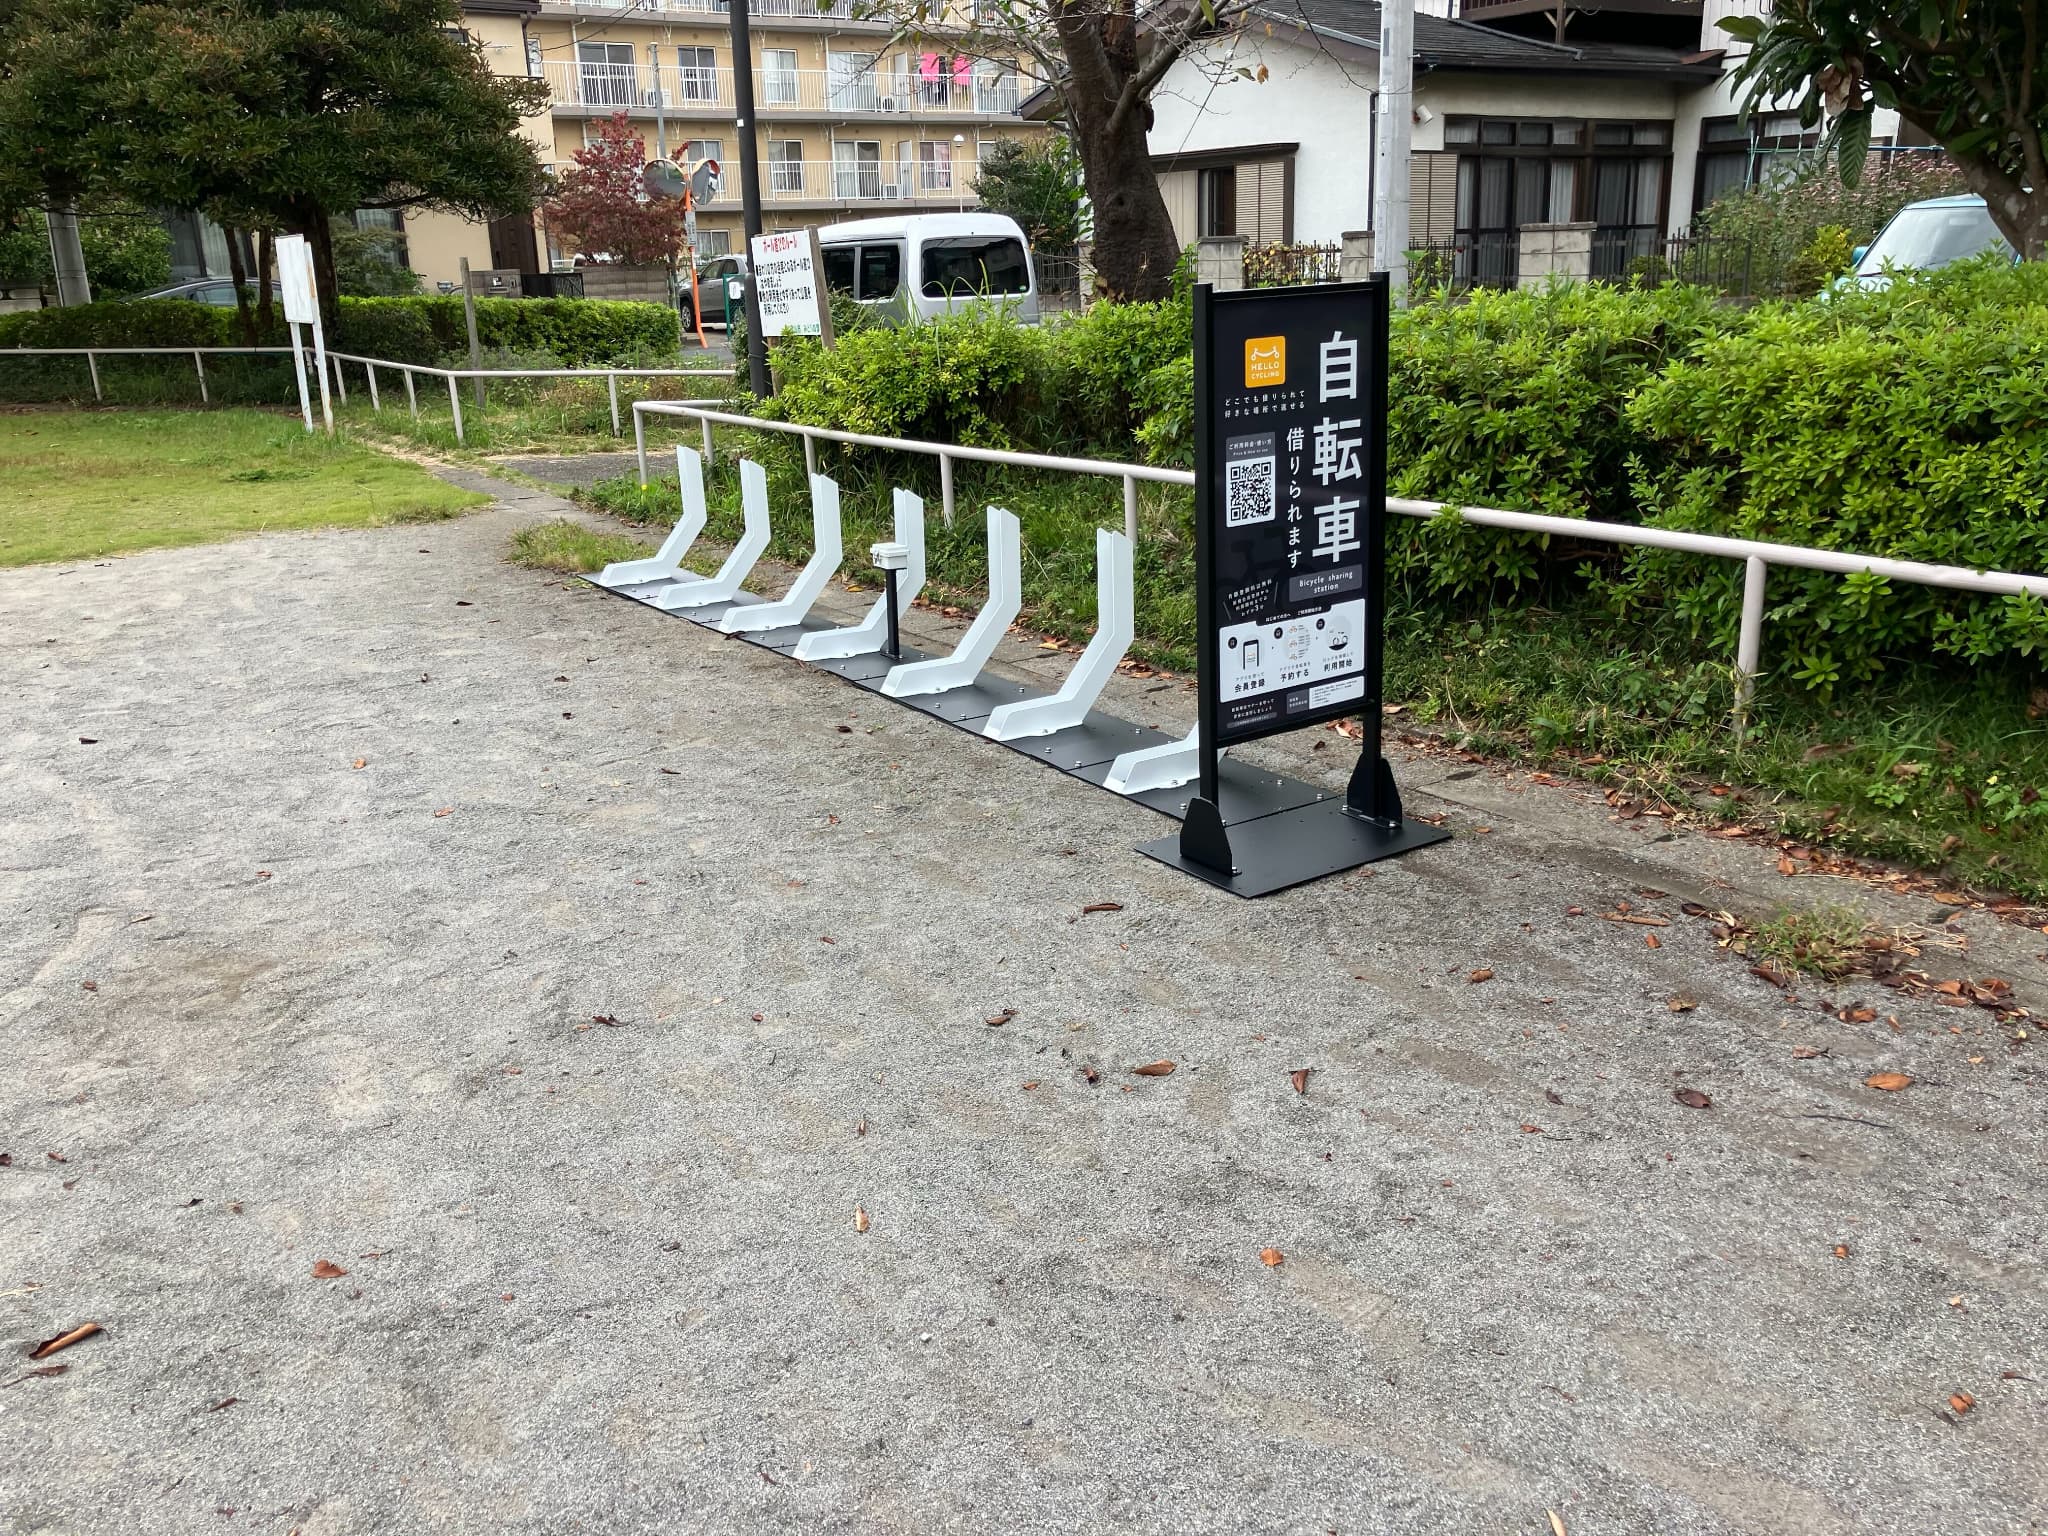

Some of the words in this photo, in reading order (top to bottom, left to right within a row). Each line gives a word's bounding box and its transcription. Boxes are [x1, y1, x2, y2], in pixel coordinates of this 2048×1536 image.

[1251, 361, 1280, 371] HELLO
[1251, 370, 1280, 380] CYCLING
[1224, 389, 1305, 407] どこでも借りられて
[1224, 401, 1305, 419] 好きな場所で返せる
[1312, 330, 1363, 563] 自転車
[1286, 427, 1305, 569] 借りられます
[1299, 575, 1325, 587] Bicycle
[1328, 570, 1353, 581] sharing
[1313, 583, 1339, 594] station
[1323, 658, 1353, 673] 利用開始
[1280, 668, 1310, 683] 予約する
[1234, 678, 1265, 693] 会員登録
